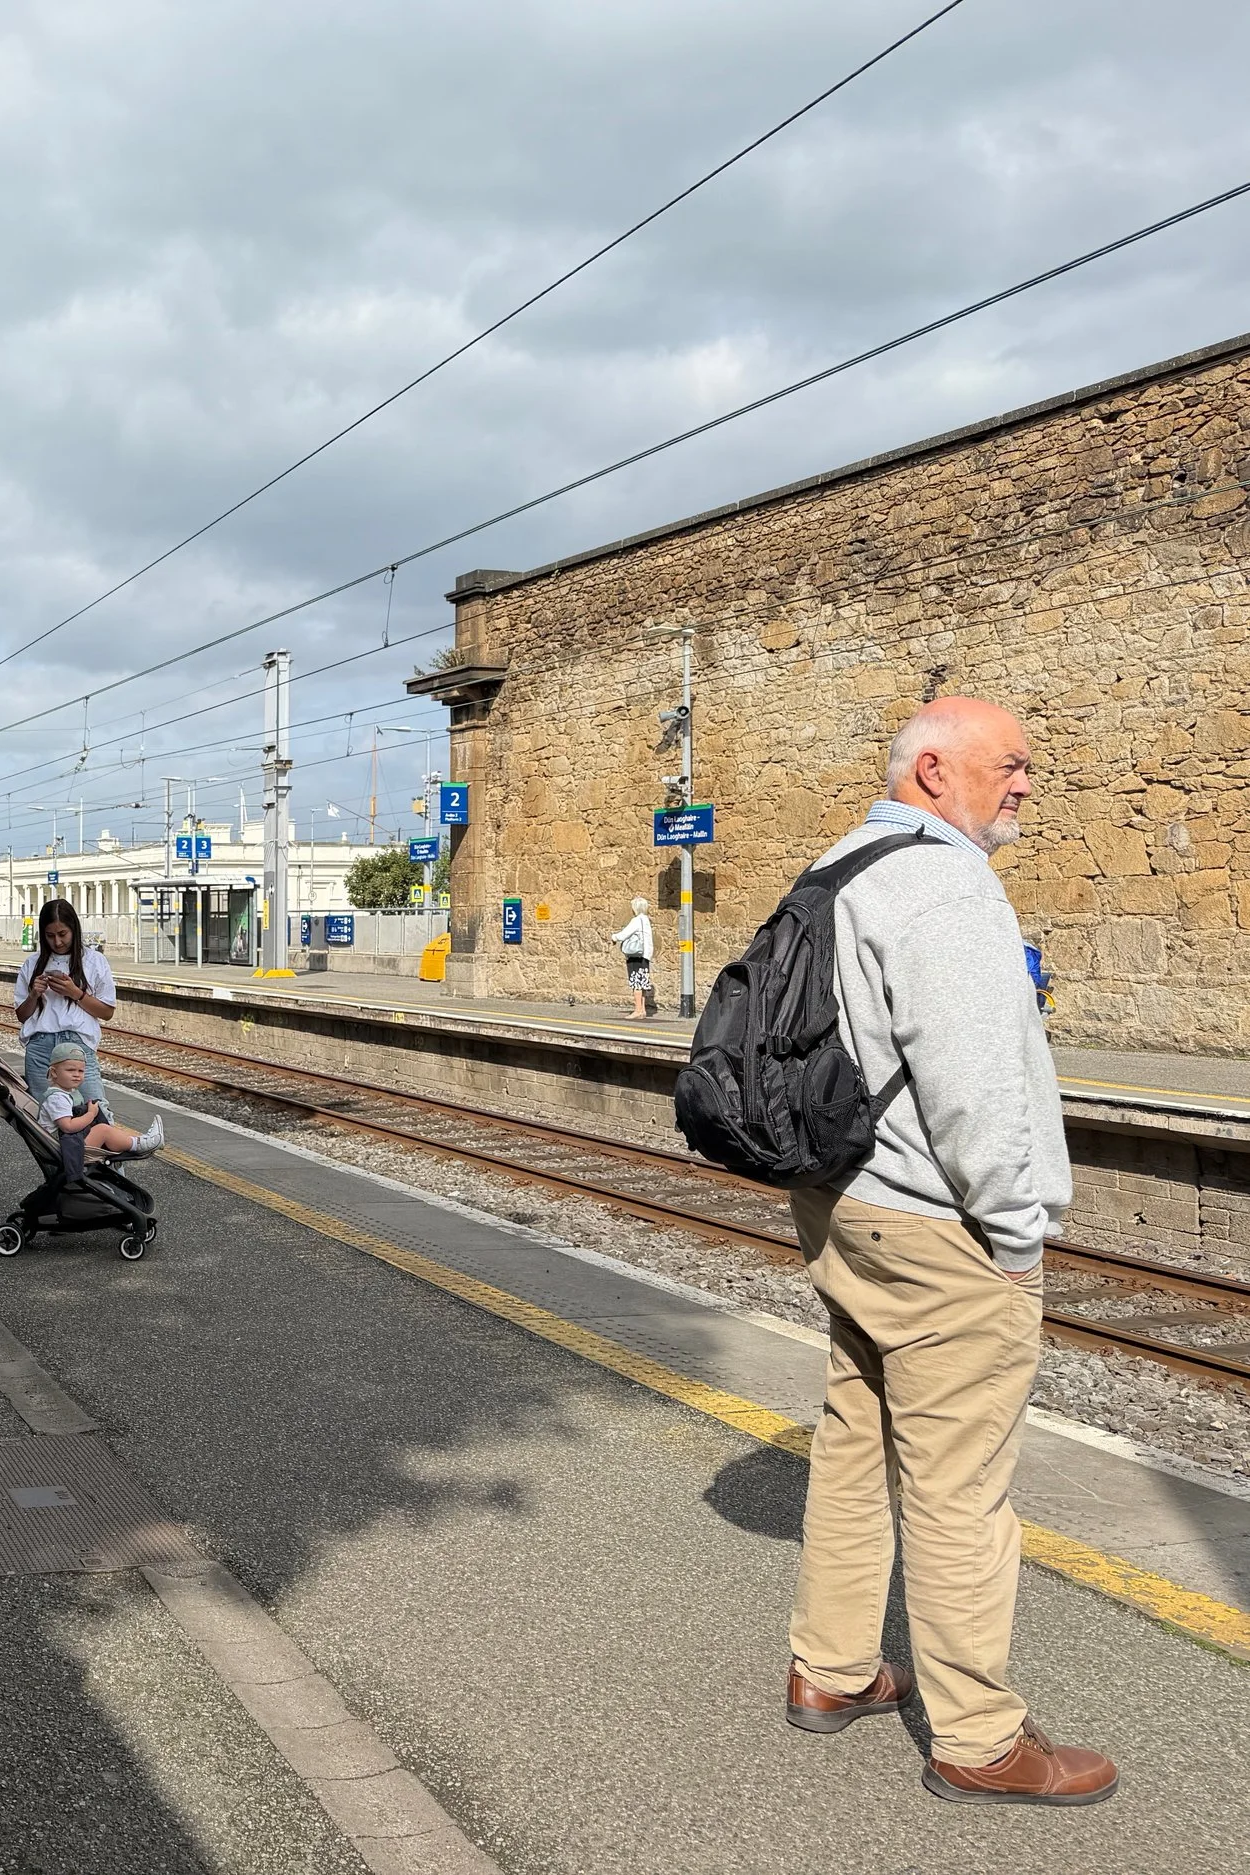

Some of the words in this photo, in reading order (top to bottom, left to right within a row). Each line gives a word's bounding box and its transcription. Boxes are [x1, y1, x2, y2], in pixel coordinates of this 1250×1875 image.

[450, 792, 460, 807] 2
[181, 839, 188, 849] 2
[201, 840, 207, 850] 3
